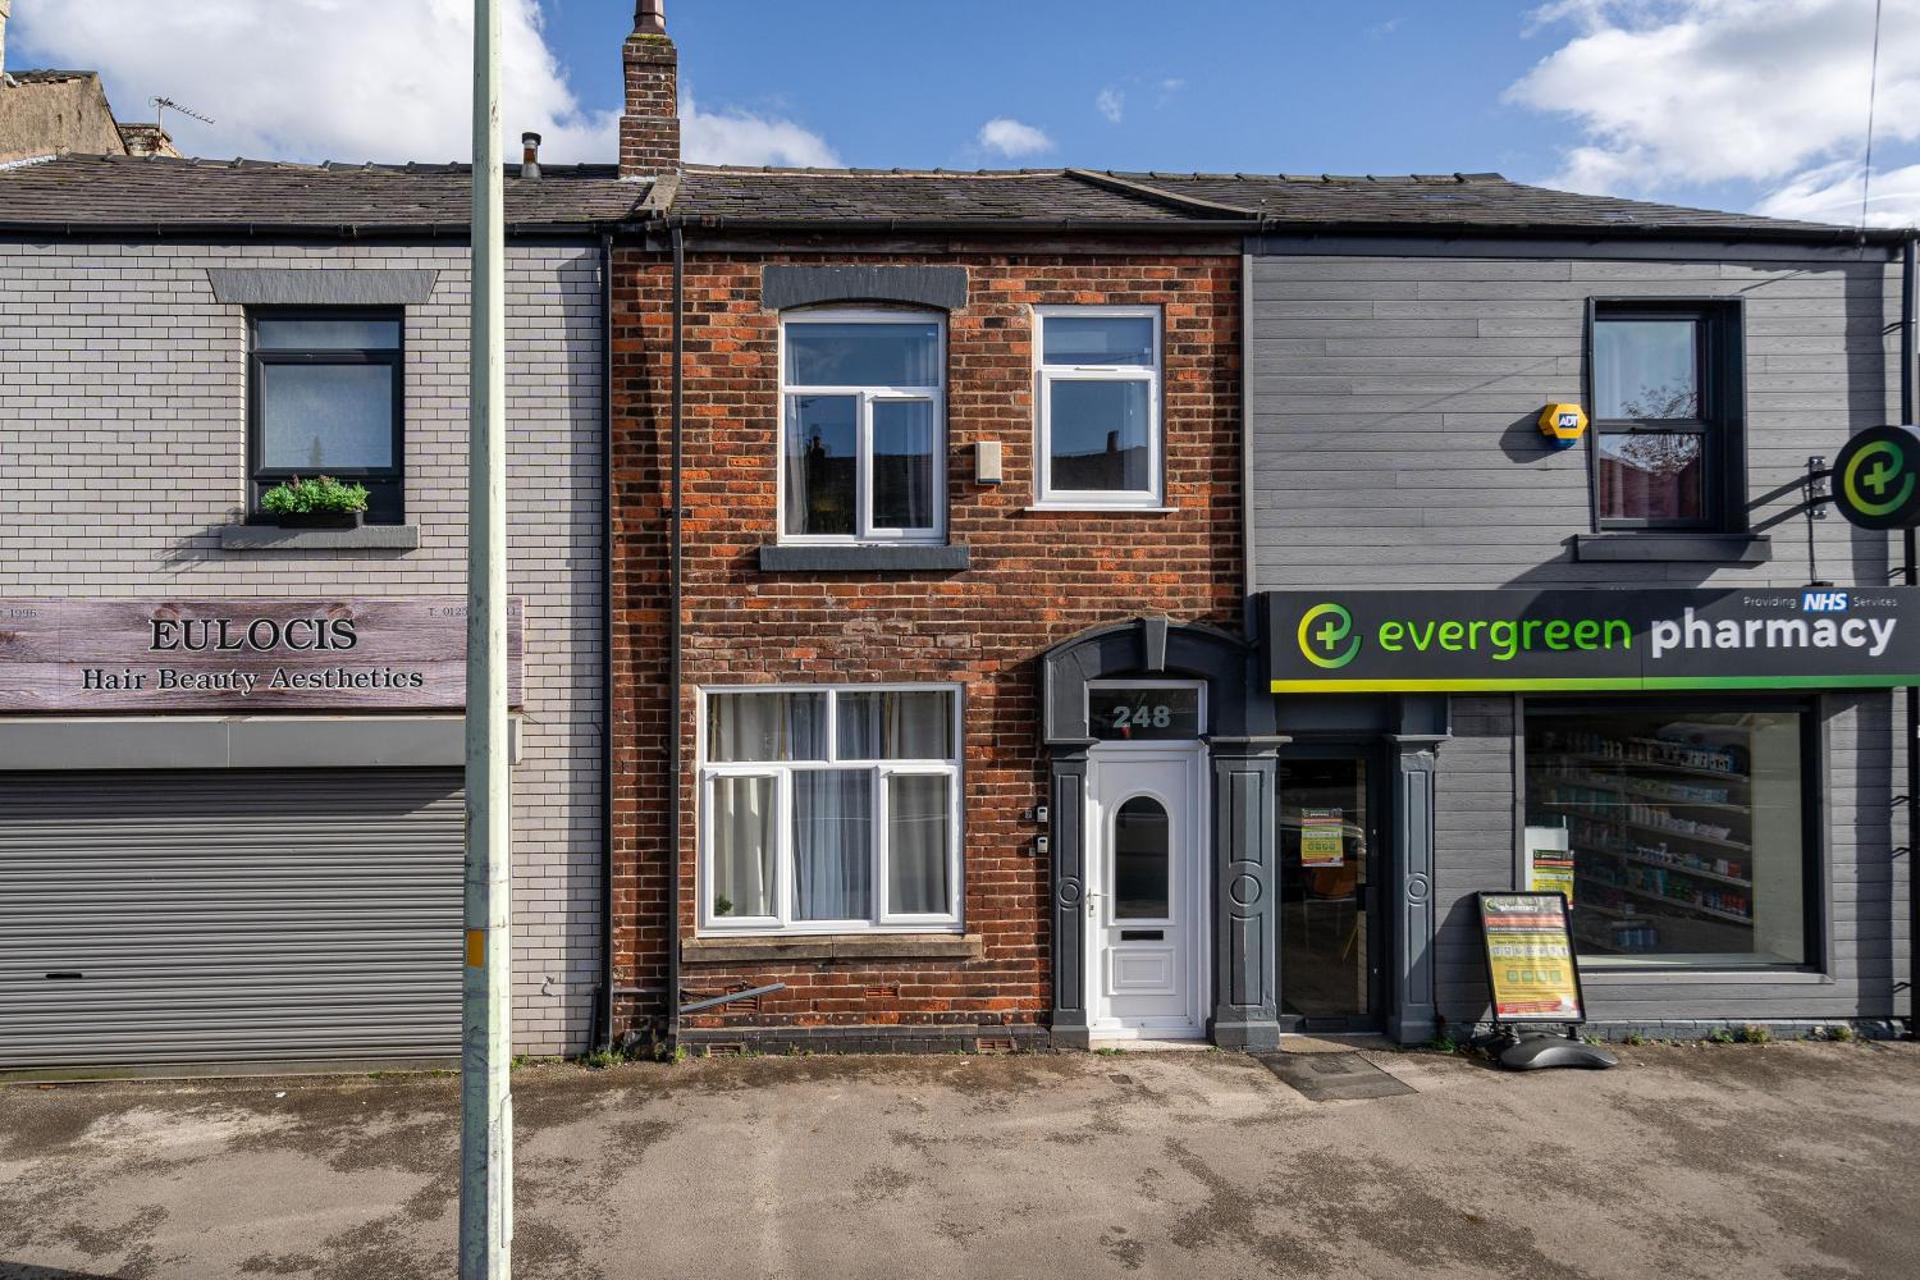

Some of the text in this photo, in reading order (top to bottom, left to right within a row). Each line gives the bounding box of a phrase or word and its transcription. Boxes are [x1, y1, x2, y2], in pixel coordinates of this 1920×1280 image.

[1559, 415, 1578, 427] ADT
[1744, 593, 1898, 610] Providing NHS Services
[149, 618, 357, 652] EULOCIS
[1379, 607, 1897, 660] evergreen pharmacy
[82, 666, 424, 695] Hair Beauty Aesthetics
[1112, 705, 1171, 729] 248
